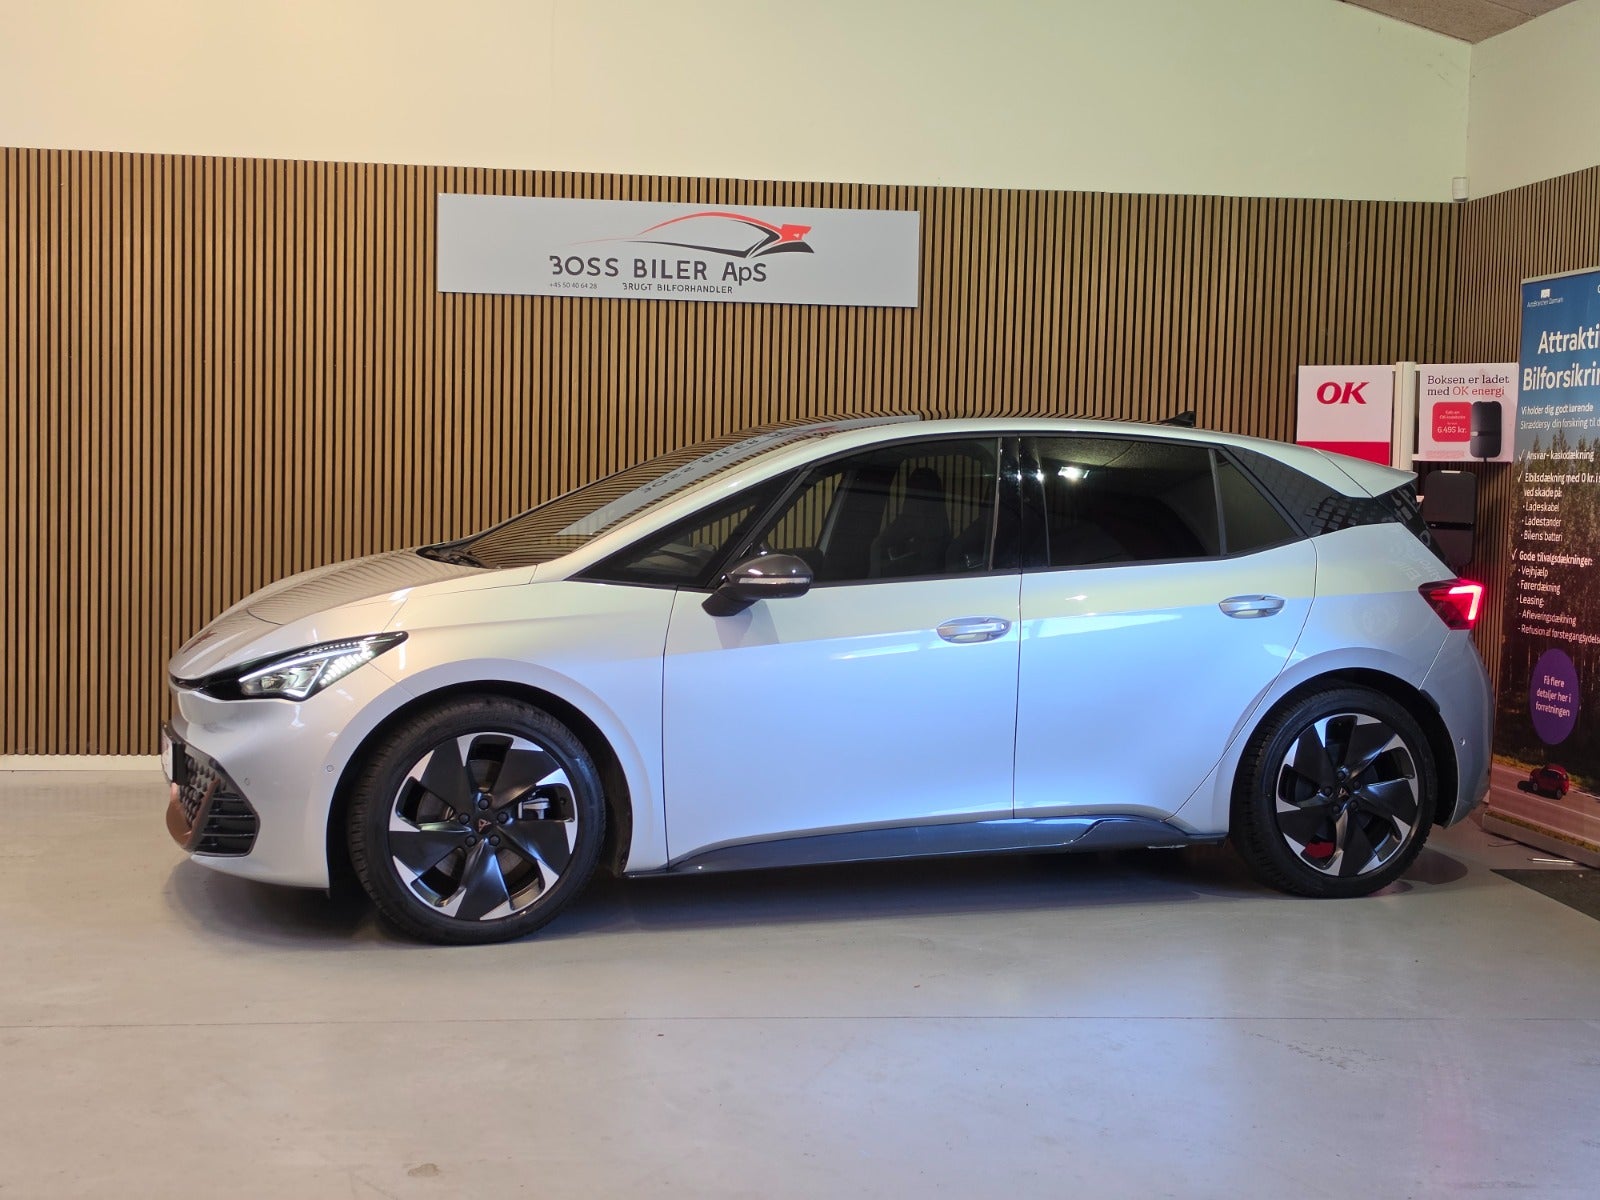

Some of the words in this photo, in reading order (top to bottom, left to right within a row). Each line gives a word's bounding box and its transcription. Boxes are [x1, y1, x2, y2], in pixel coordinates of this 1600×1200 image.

[549, 255, 619, 277] BOSS
[633, 258, 707, 281] BILER
[721, 261, 767, 286] ApS
[622, 282, 652, 291] BRUGT
[657, 283, 733, 294] BILFORHANDLER
[1427, 375, 1465, 385] Boksen
[1482, 374, 1510, 384] ladet
[1316, 381, 1370, 405] OK
[1427, 386, 1450, 395] med
[1452, 386, 1469, 395] OK
[1471, 386, 1505, 398] energi
[1521, 406, 1527, 415] Vi
[1527, 405, 1544, 415] holder
[1544, 404, 1554, 416] dig
[1555, 404, 1568, 416] godt
[1457, 426, 1467, 434] kr.
[1551, 418, 1562, 428] din
[1562, 417, 1588, 430] forsikring
[1524, 472, 1565, 485] Elbilsdækning
[1565, 472, 1580, 483] med
[1581, 473, 1586, 482] 0
[1587, 472, 1595, 483] kr.
[1524, 487, 1534, 497] ved
[1534, 487, 1554, 497] skade
[1525, 501, 1560, 512] Ladeskabel
[1524, 516, 1562, 527] Ladestander
[1523, 530, 1543, 541] Bilens
[1544, 531, 1563, 542] batteri
[1519, 550, 1536, 562] Gode
[1521, 565, 1549, 579] Vejhjælp
[1520, 579, 1561, 595] Førerdækning
[1521, 609, 1577, 627] Afleveringsdækning
[1521, 624, 1546, 635] Refusion
[1545, 628, 1552, 637] af
[1543, 675, 1550, 685] Få
[1550, 676, 1565, 688] flere
[1536, 687, 1557, 701] detaljer
[1557, 692, 1568, 702] her
[1535, 701, 1570, 718] forretningen
